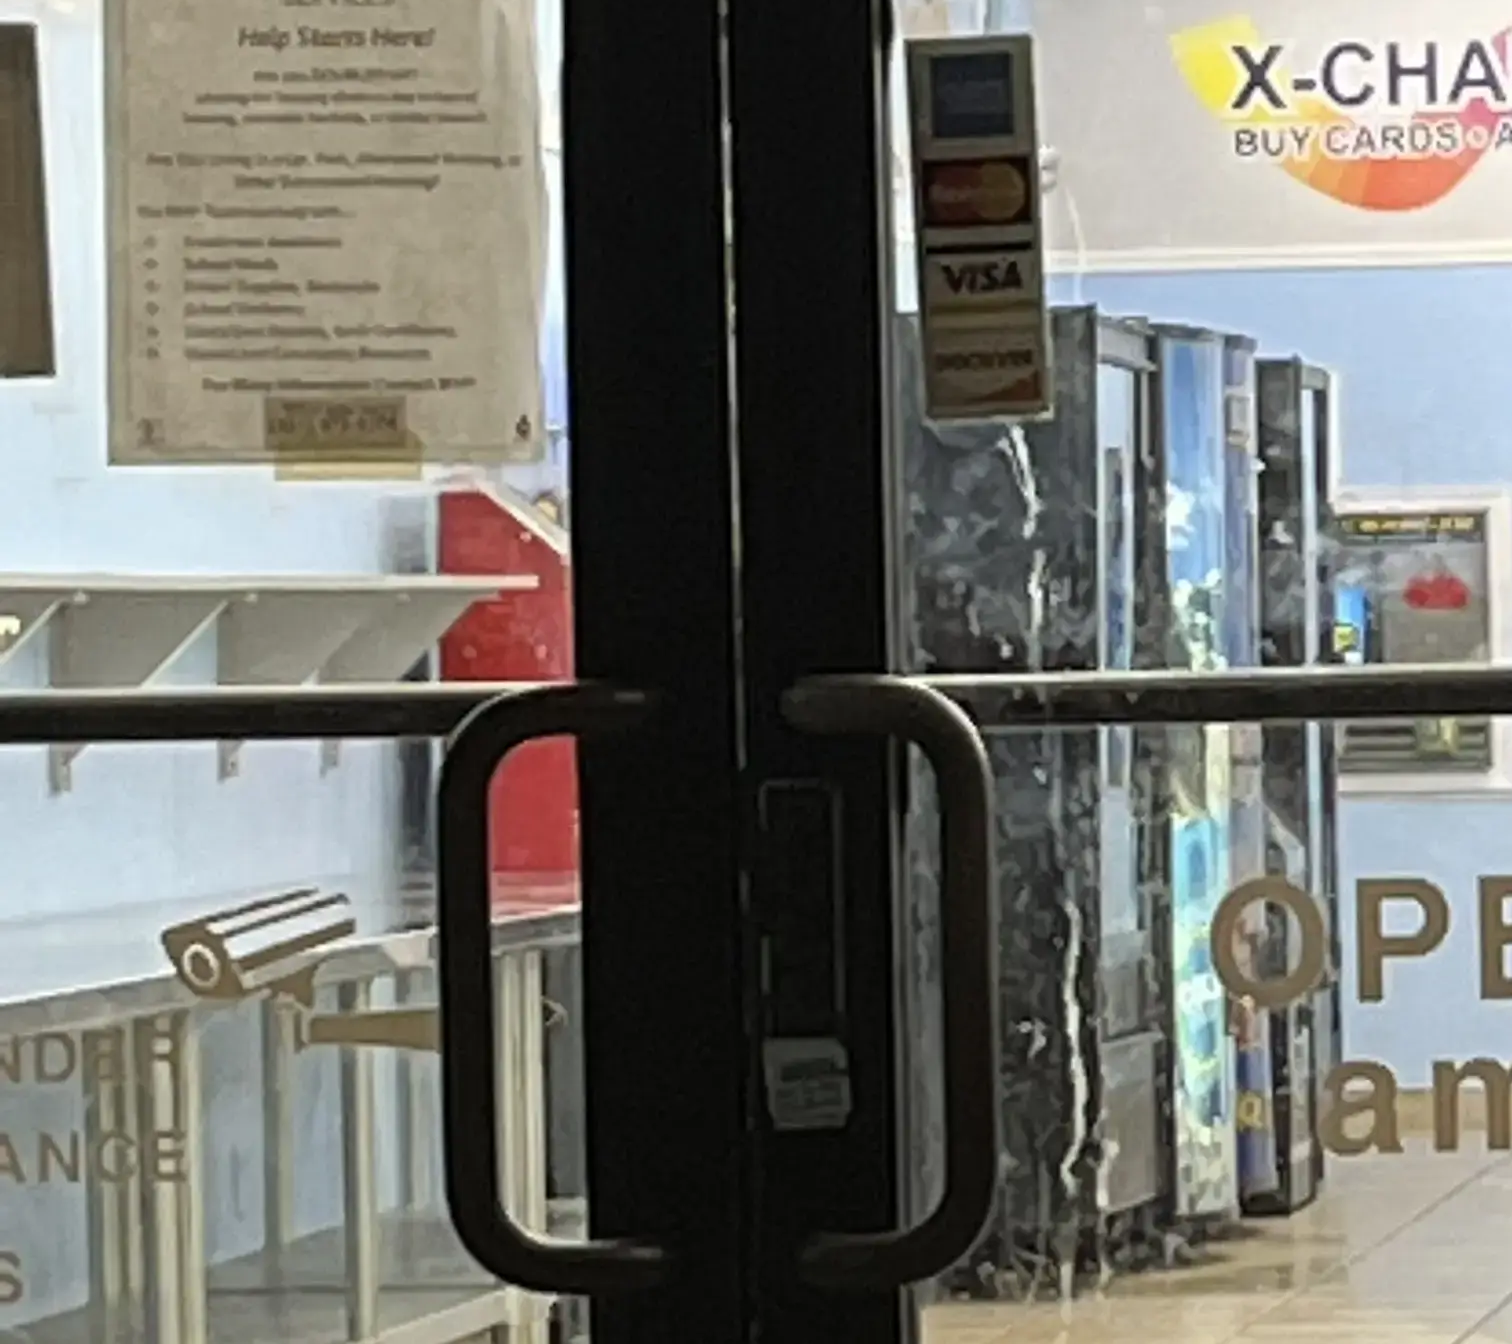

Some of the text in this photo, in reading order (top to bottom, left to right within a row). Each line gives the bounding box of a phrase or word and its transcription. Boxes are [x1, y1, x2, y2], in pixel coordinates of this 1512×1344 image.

[1234, 126, 1311, 158] BUY
[1325, 122, 1458, 155] CARDS
[941, 261, 1024, 296] VISA
